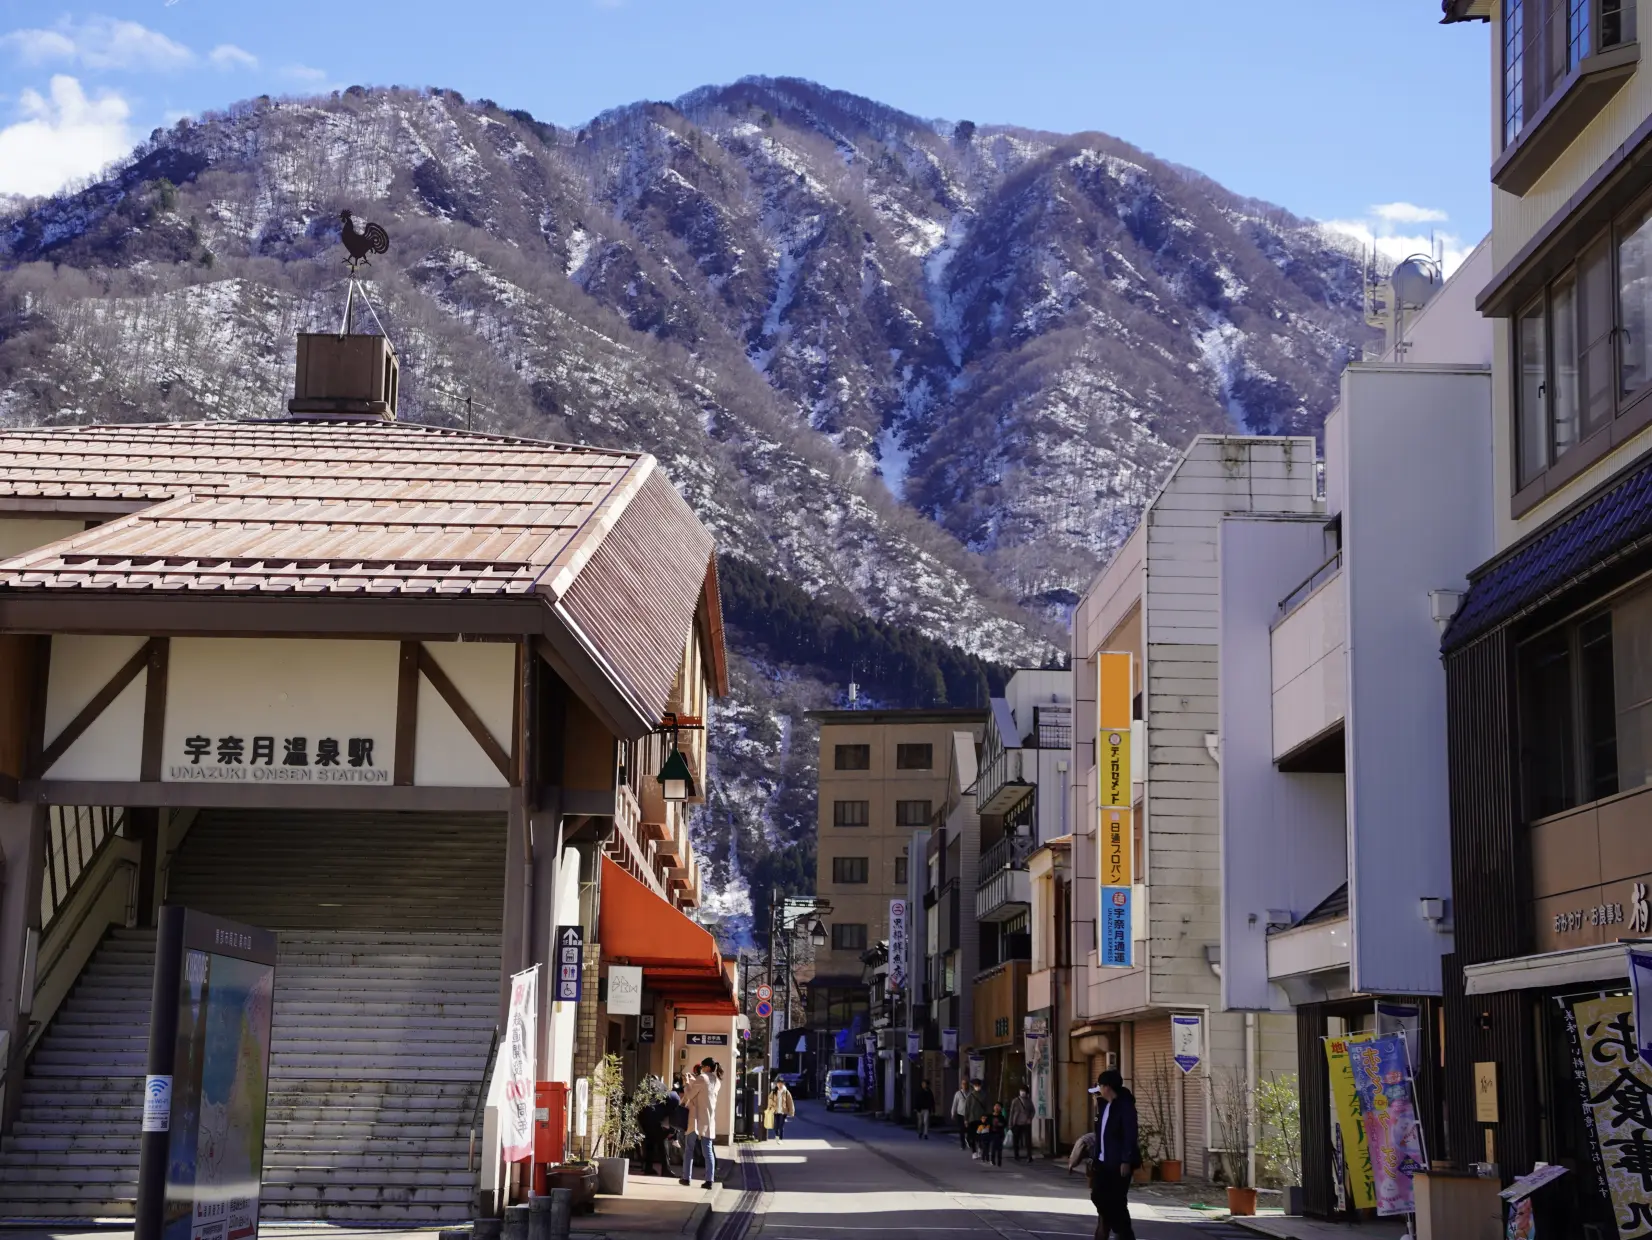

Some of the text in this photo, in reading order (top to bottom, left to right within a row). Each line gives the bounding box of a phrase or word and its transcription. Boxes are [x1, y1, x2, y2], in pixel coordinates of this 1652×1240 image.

[183, 734, 375, 768] 宇奈月温泉駅
[170, 765, 388, 782] UNAZUKI ONSEN STATION
[1110, 746, 1120, 805] デンカセメント
[1110, 822, 1121, 884] 日通プロパン
[1113, 908, 1125, 963] 宇奈月通運
[760, 989, 769, 997] 30
